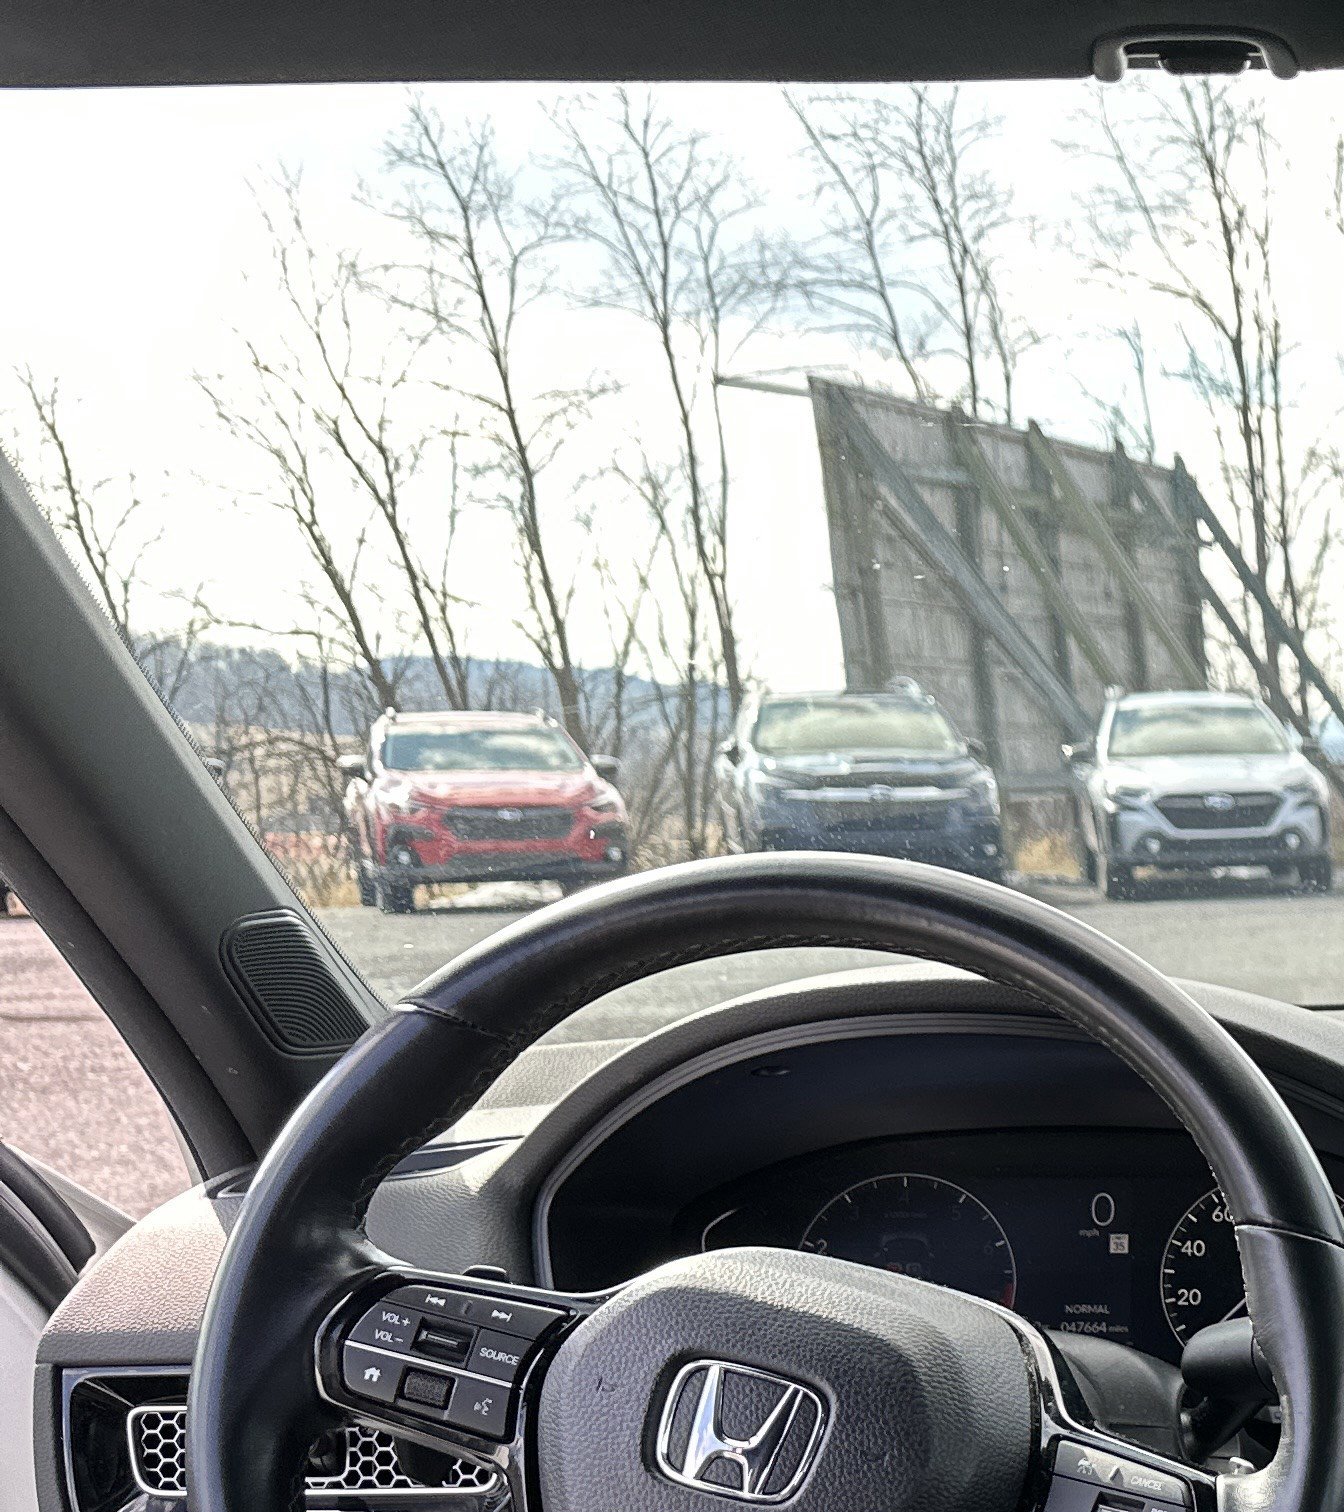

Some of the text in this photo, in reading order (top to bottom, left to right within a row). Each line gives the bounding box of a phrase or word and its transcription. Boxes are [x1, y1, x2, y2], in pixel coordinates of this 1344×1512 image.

[1091, 1192, 1115, 1227] 0
[1112, 1241, 1125, 1250] 35
[1181, 1240, 1205, 1257] 40
[1177, 1289, 1201, 1305] 20
[1065, 1304, 1110, 1315] NORMAL
[479, 1347, 520, 1366] SOURCE
[1130, 1476, 1164, 1491] CANCEL
